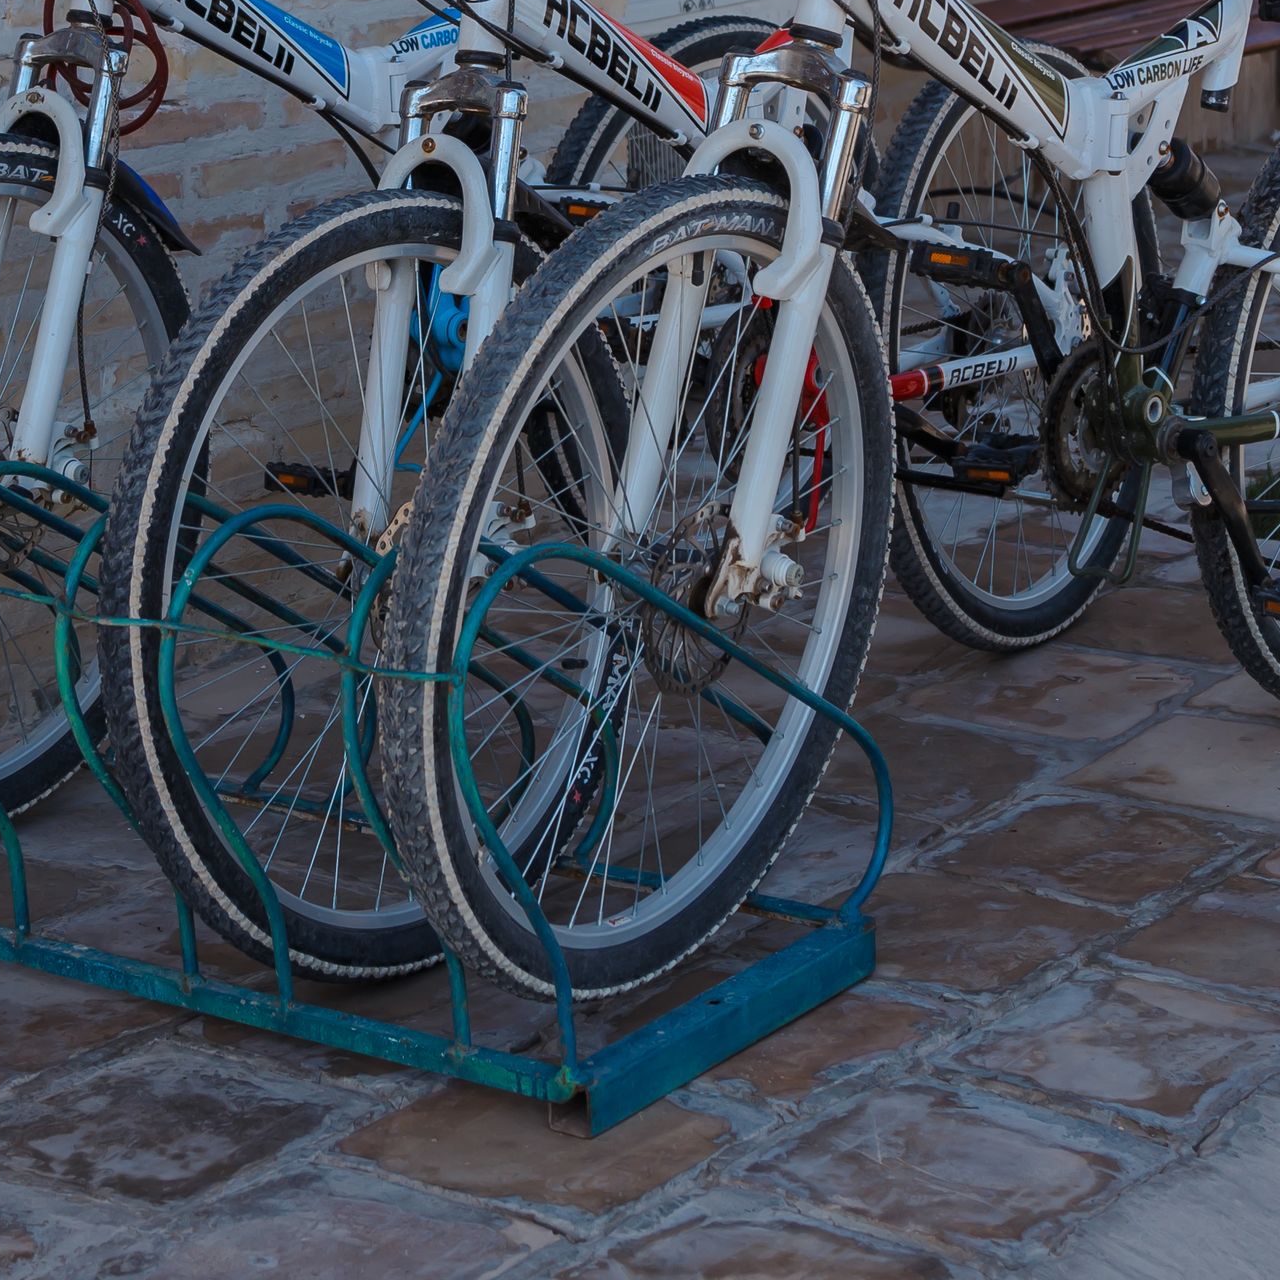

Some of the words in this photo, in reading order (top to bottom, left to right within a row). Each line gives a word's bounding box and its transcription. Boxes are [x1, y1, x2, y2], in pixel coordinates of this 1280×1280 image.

[391, 36, 420, 55] LOW
[420, 28, 459, 50] CARBO
[1106, 69, 1136, 91] LOW
[1136, 60, 1182, 86] CARBON
[1182, 55, 1204, 75] LIFE
[948, 356, 1018, 386] ACBELII
